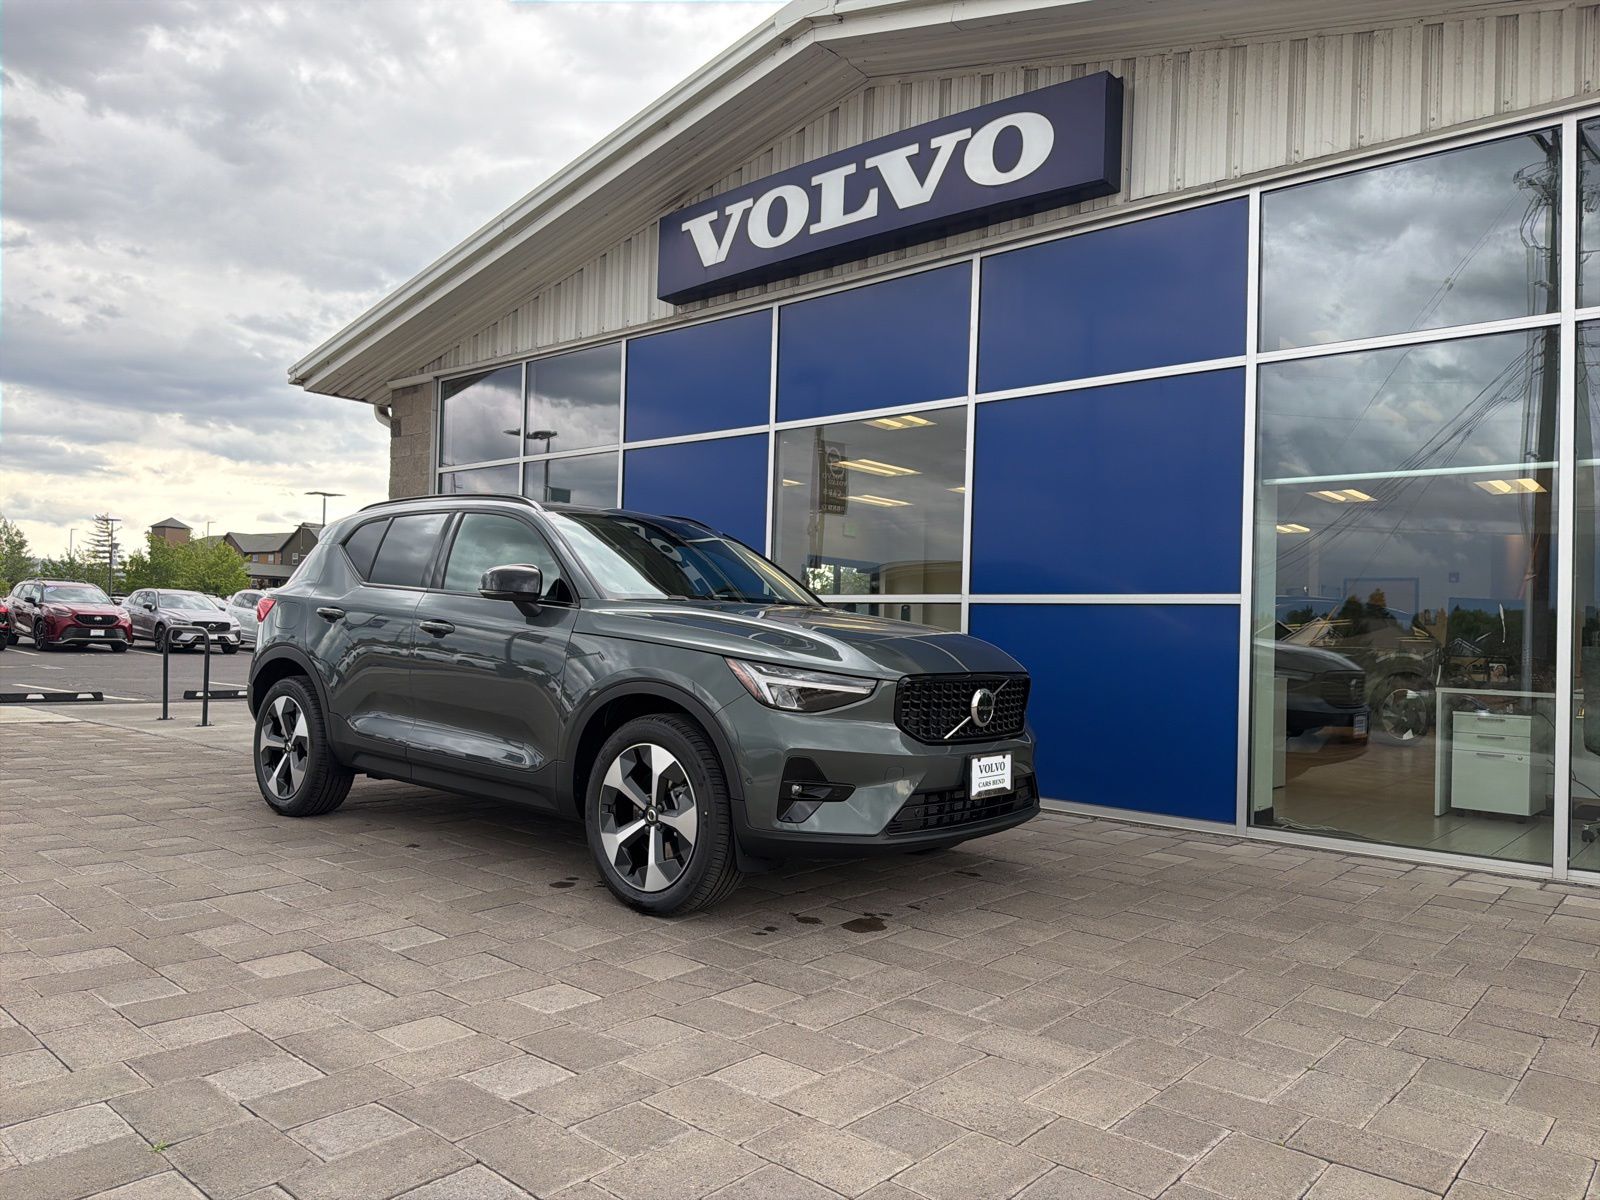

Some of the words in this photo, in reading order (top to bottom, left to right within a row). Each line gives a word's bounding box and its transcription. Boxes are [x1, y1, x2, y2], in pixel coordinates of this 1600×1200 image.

[681, 111, 1055, 268] VOLVO
[979, 761, 1005, 774] VOLVO
[978, 780, 991, 788] CARS
[992, 778, 1005, 786] BEND
